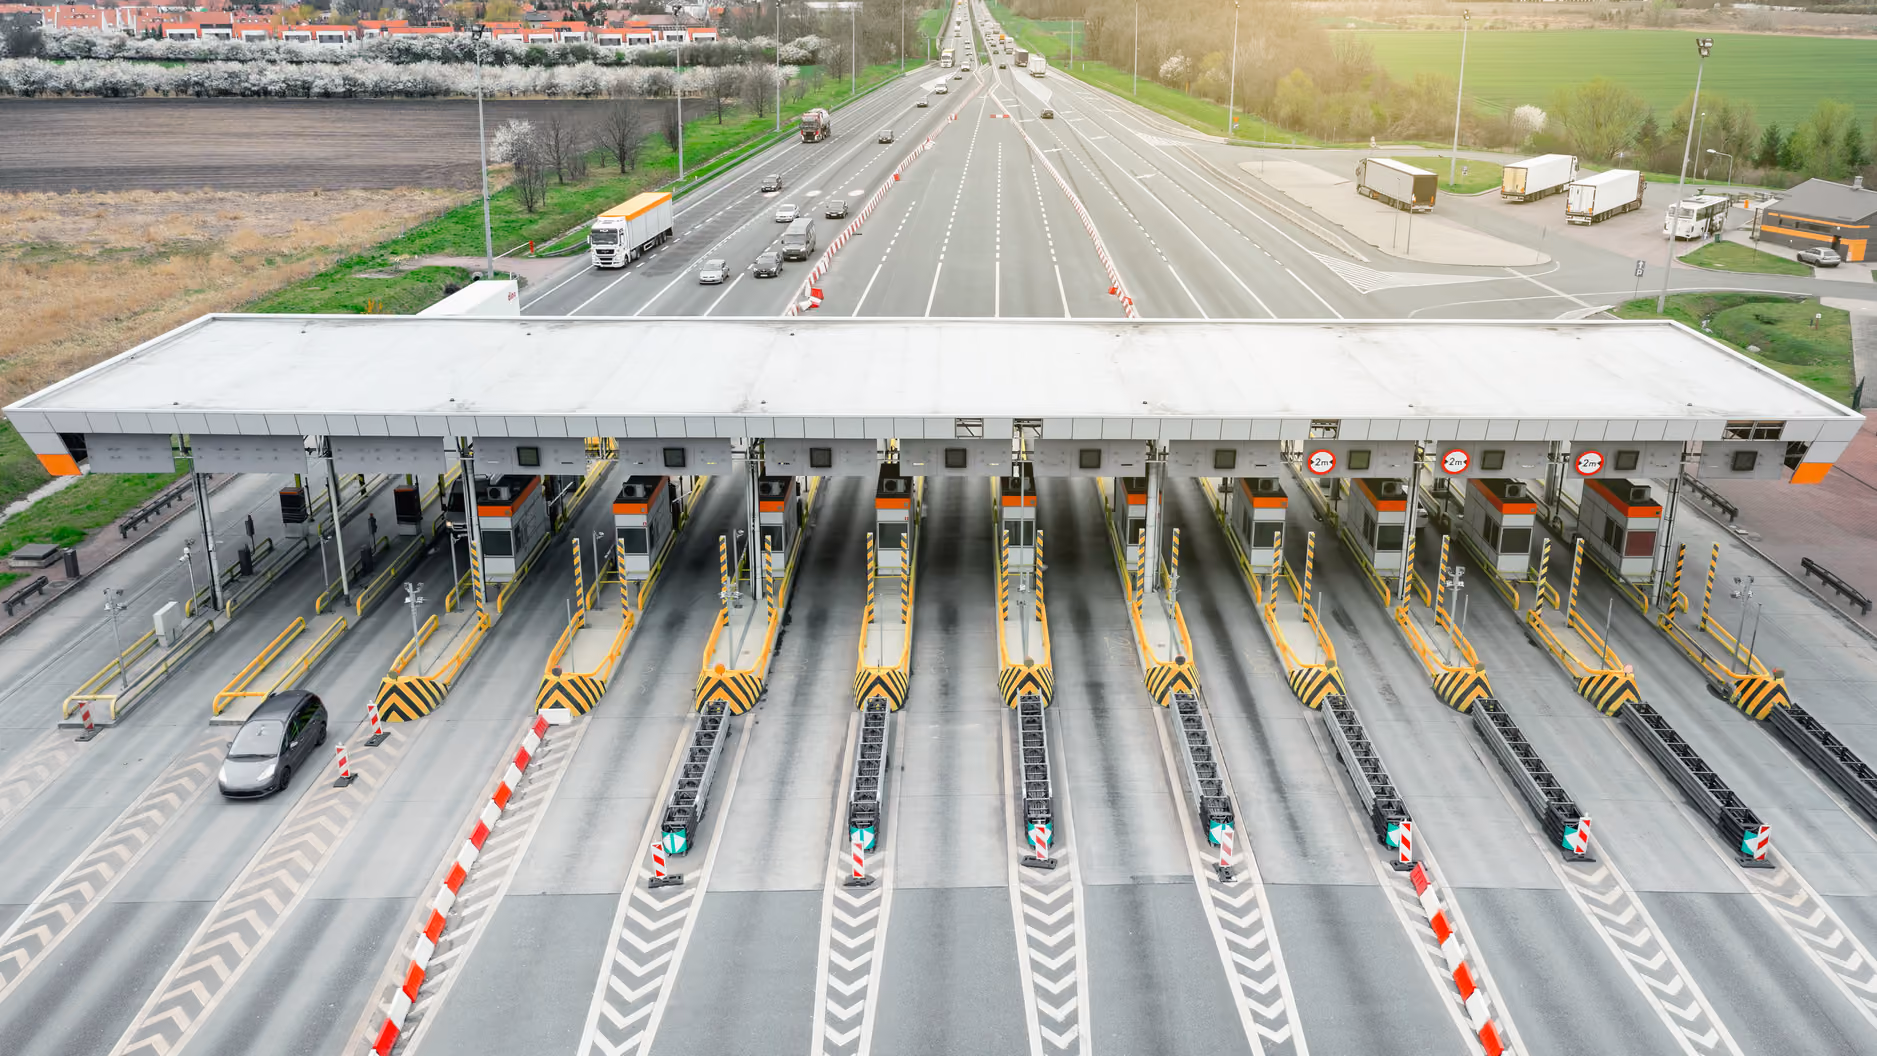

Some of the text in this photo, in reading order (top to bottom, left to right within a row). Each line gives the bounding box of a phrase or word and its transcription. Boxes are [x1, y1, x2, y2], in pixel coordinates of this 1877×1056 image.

[1315, 457, 1328, 466] 2m
[1448, 457, 1462, 466] 2m
[1583, 458, 1597, 468] 2m
